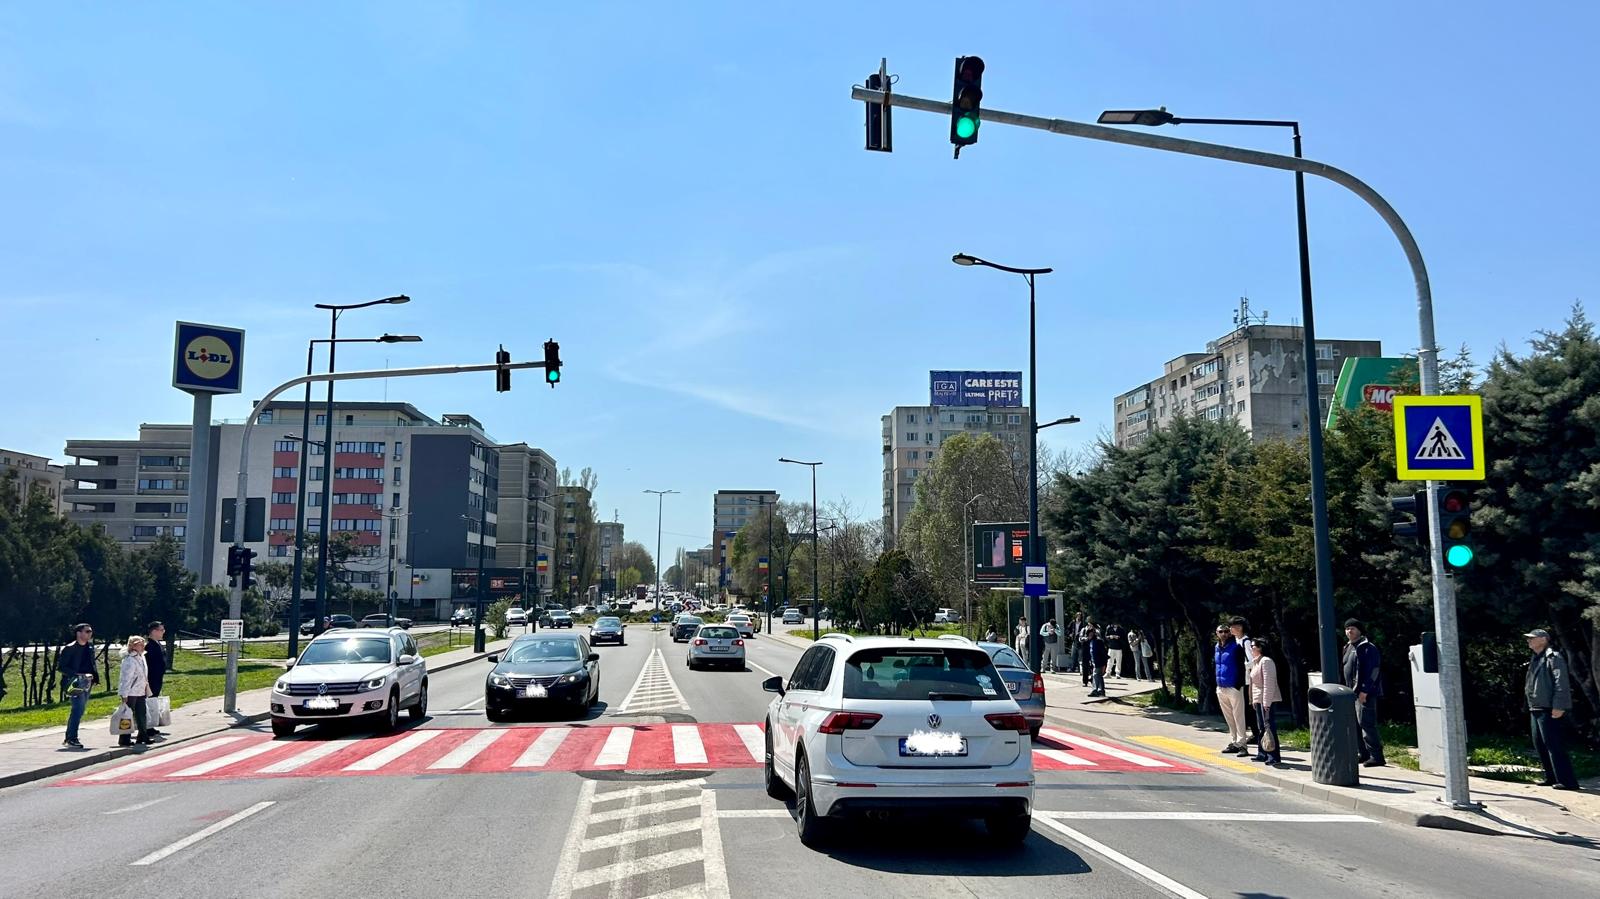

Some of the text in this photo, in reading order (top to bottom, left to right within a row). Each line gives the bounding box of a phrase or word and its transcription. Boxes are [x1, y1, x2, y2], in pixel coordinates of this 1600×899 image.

[187, 347, 231, 364] LIDL
[964, 379, 1019, 388] CARE ESTE
[1371, 388, 1398, 404] MO
